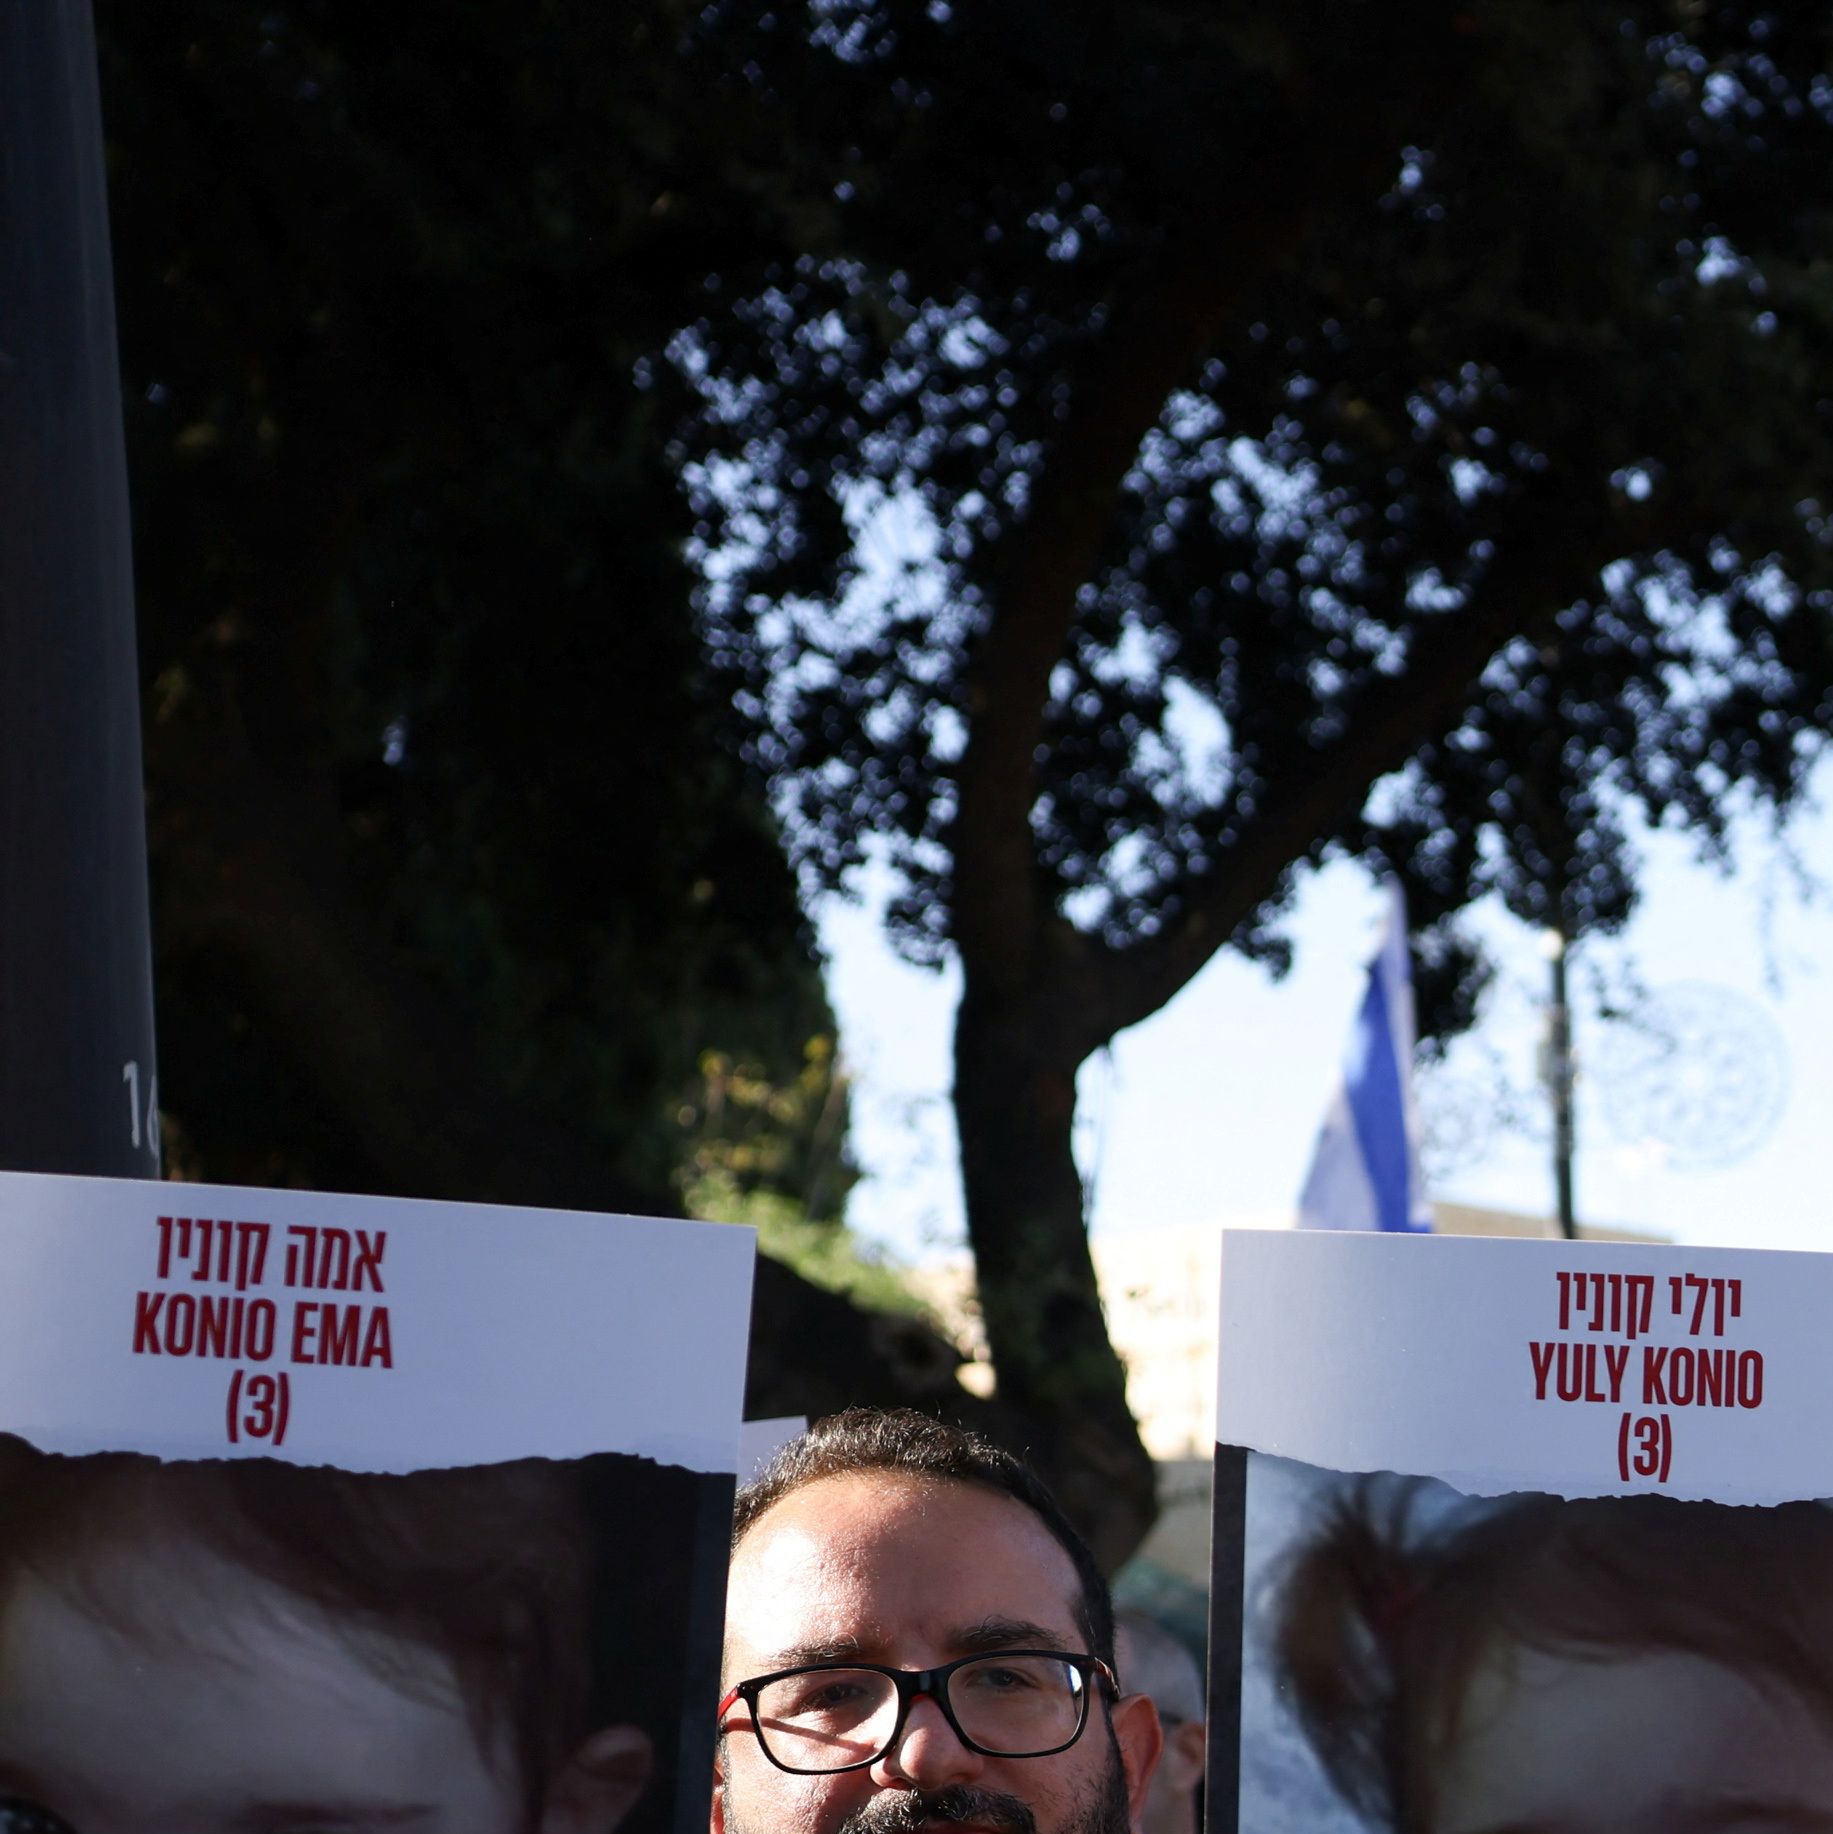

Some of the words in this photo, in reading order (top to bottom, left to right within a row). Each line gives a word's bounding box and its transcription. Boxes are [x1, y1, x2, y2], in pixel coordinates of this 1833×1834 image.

[157, 1217, 270, 1291] קוניו
[286, 1226, 387, 1292] אמה
[133, 1291, 276, 1361] KONIO
[290, 1301, 393, 1368] EMA
[1556, 1271, 1654, 1338] קוניו
[1670, 1273, 1742, 1337] יולי
[226, 1370, 292, 1445] (3)
[1530, 1341, 1630, 1403] YULY
[1642, 1345, 1764, 1409] KONIO
[1618, 1413, 1673, 1483] (3)
